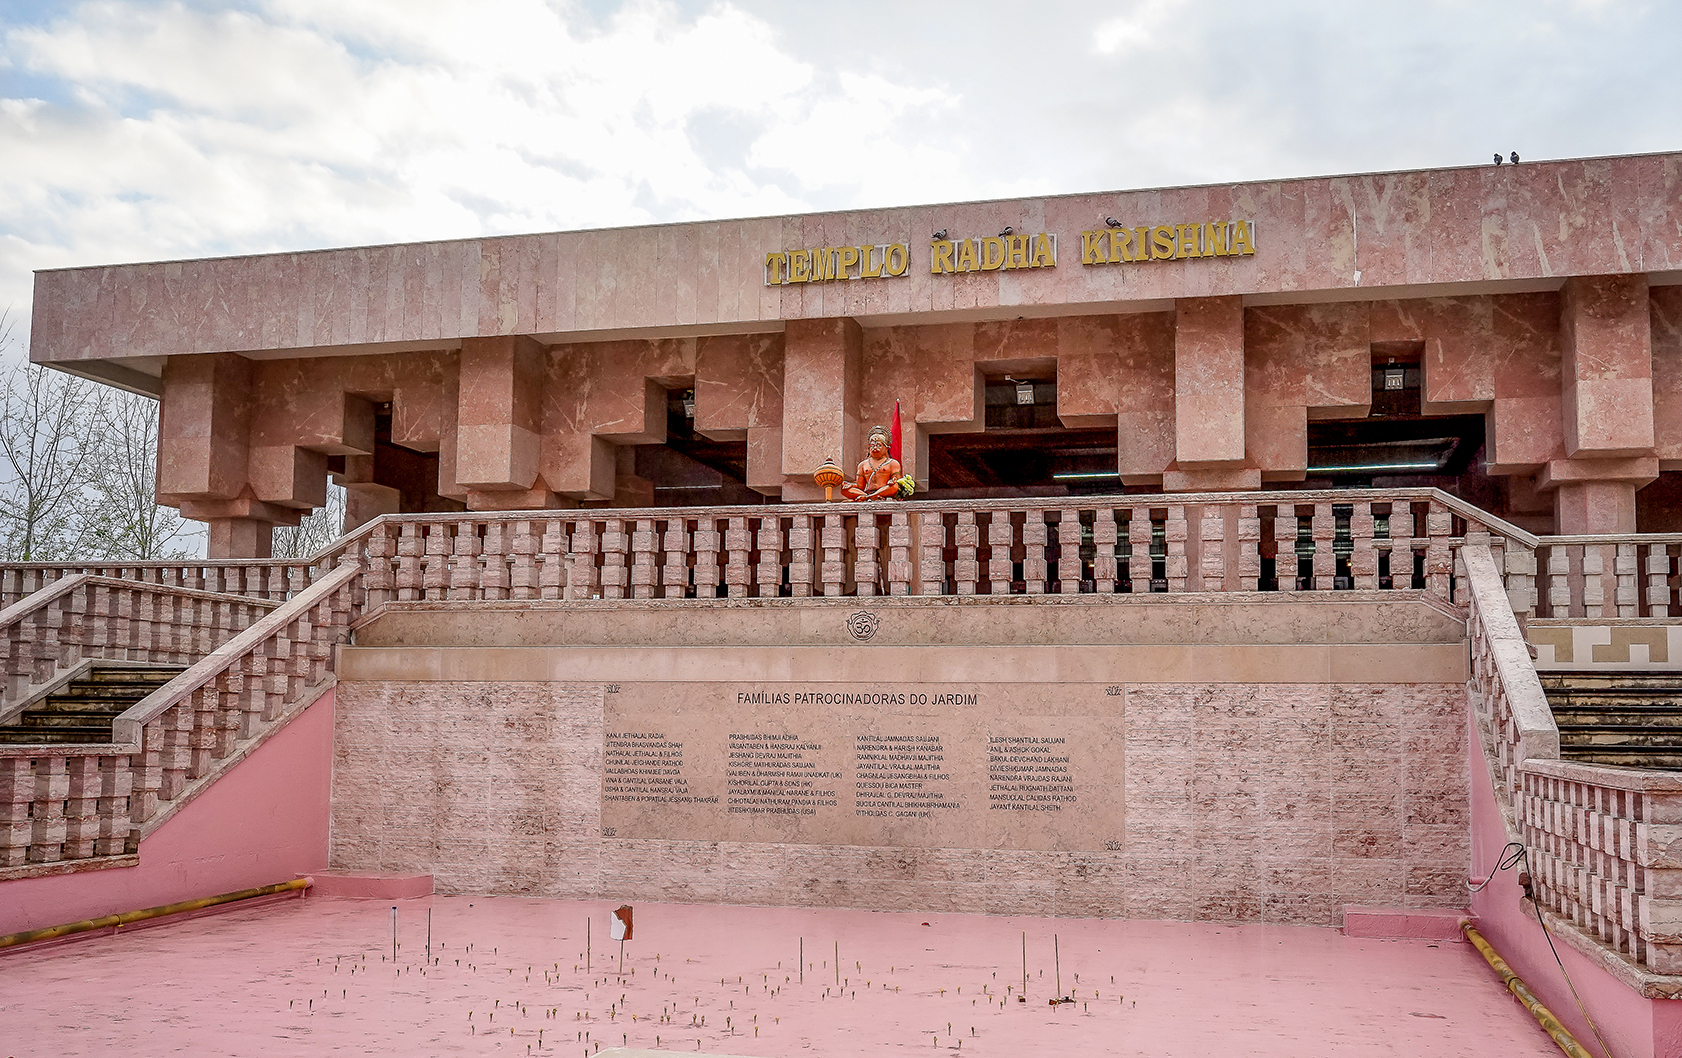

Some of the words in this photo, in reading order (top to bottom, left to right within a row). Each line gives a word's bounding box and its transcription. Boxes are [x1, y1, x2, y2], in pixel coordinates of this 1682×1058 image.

[765, 243, 908, 286] TEMPLO
[930, 232, 1057, 274] RADHA
[1081, 220, 1255, 266] KRISHNA
[737, 690, 790, 704] FAMÍLIAS
[794, 693, 905, 705] PATROCINADORAS
[910, 693, 928, 705] DO
[931, 694, 978, 705] JARDIM
